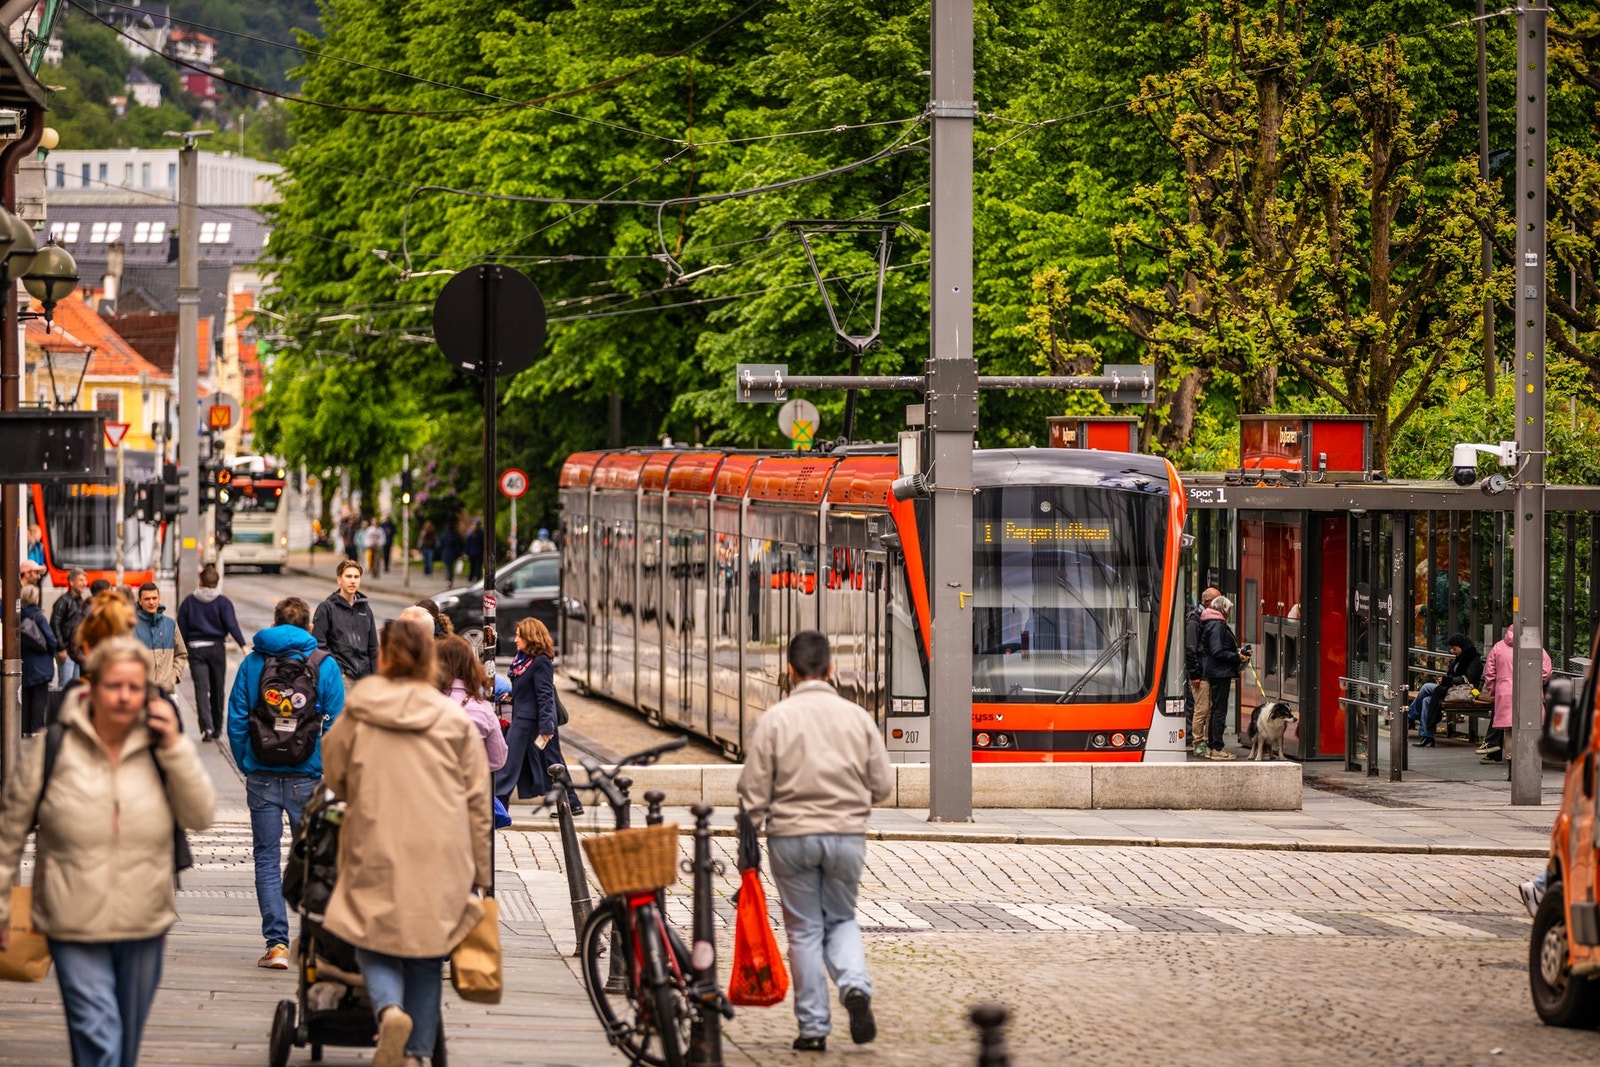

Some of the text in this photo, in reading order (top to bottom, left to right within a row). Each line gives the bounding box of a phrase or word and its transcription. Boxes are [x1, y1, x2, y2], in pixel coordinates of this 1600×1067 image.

[506, 476, 524, 489] 40
[1190, 488, 1227, 503] Spor 1
[985, 524, 992, 542] 1
[972, 713, 994, 722] yss
[905, 730, 920, 744] 207
